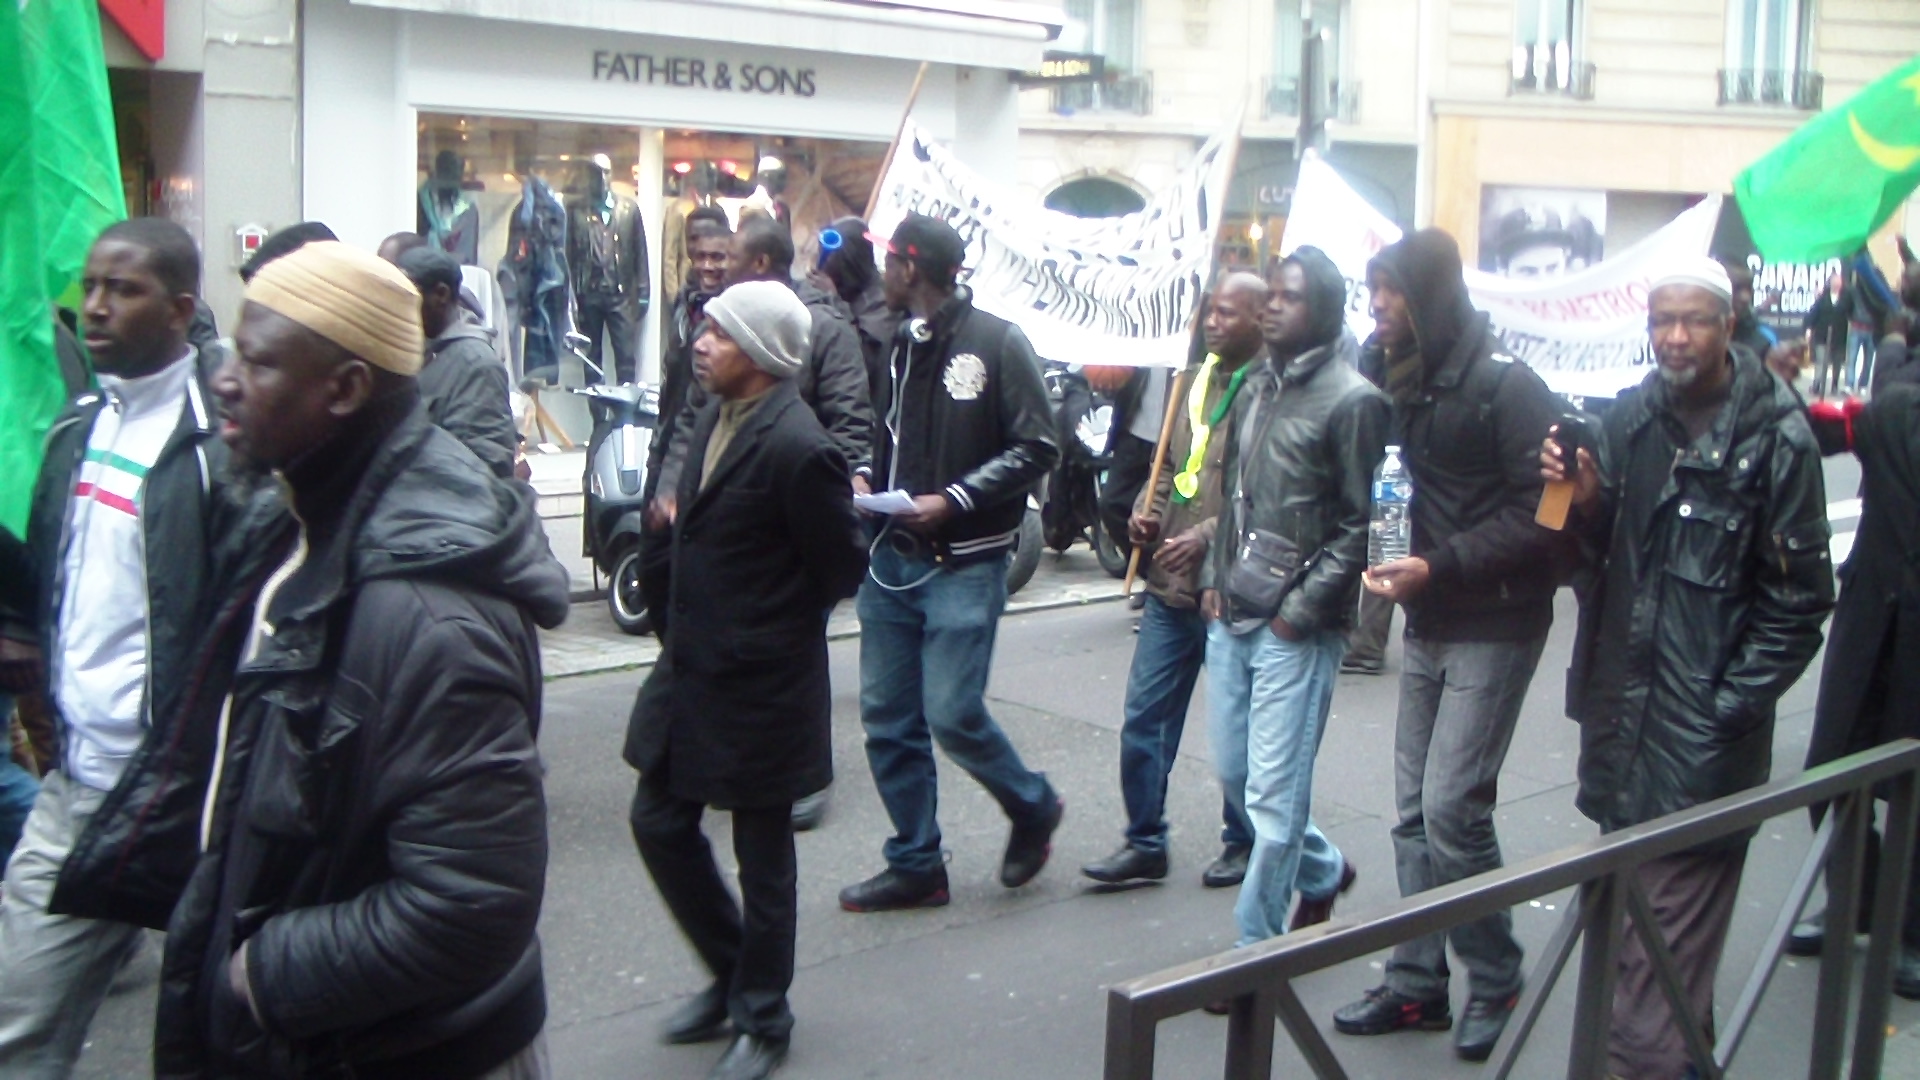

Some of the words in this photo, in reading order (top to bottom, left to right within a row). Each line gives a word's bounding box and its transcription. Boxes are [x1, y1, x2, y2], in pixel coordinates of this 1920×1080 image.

[592, 50, 708, 89] FATHER
[713, 61, 733, 90] &
[739, 63, 817, 97] SONS
